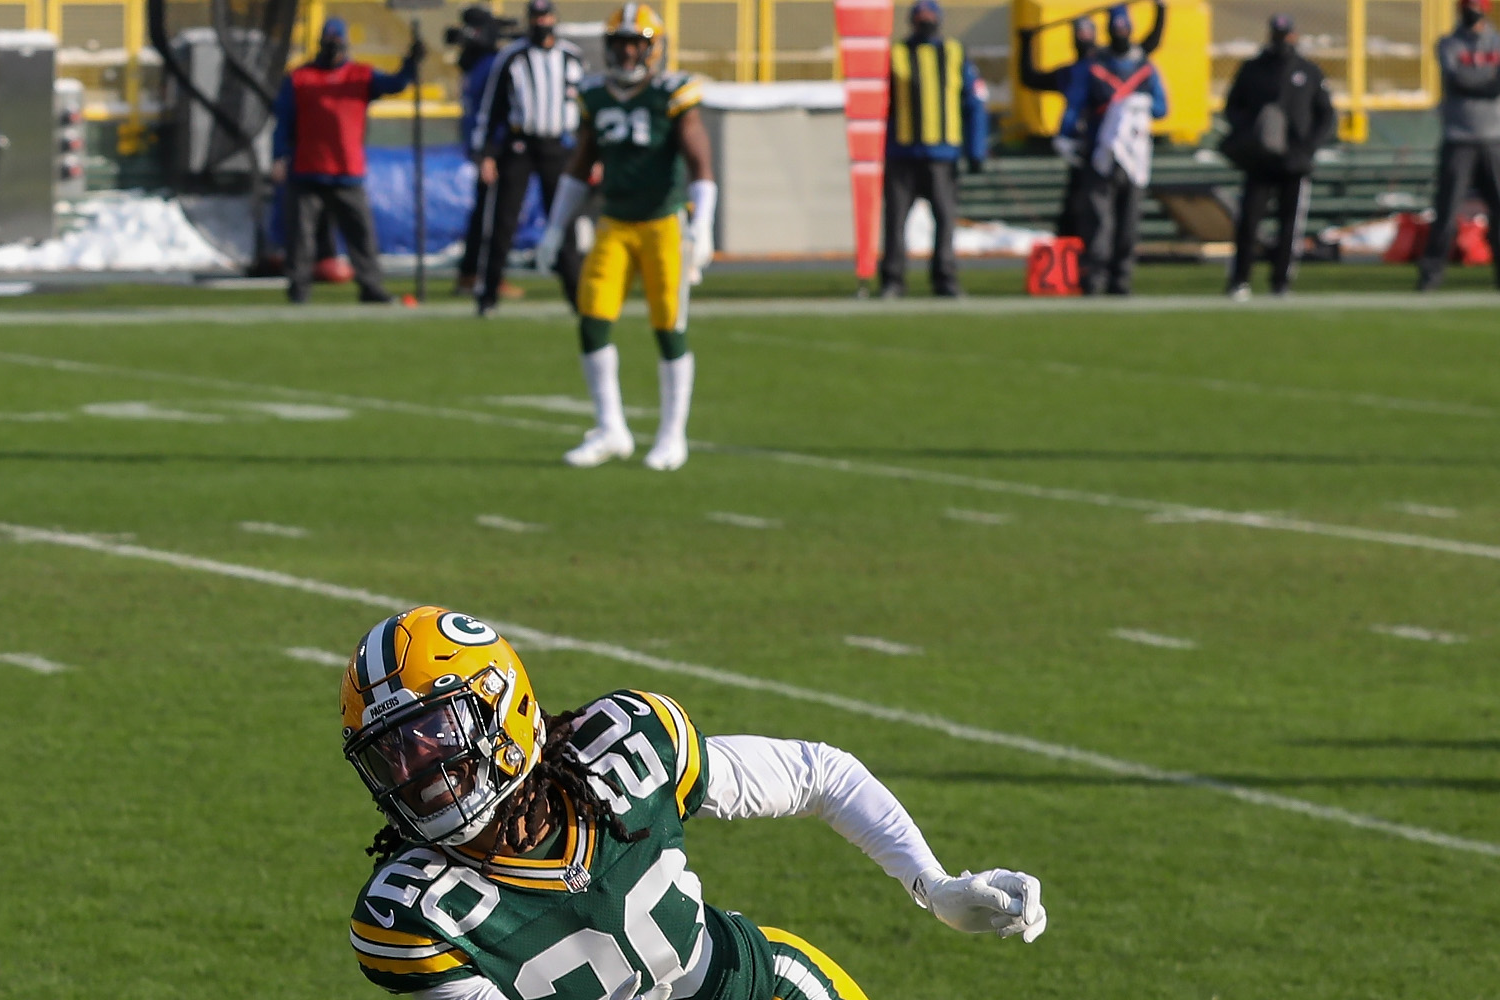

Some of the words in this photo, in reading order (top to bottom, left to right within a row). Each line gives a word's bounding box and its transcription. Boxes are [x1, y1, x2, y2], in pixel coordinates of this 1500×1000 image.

[438, 611, 500, 646] G
[369, 696, 400, 719] PACKERS
[562, 698, 669, 815] 20
